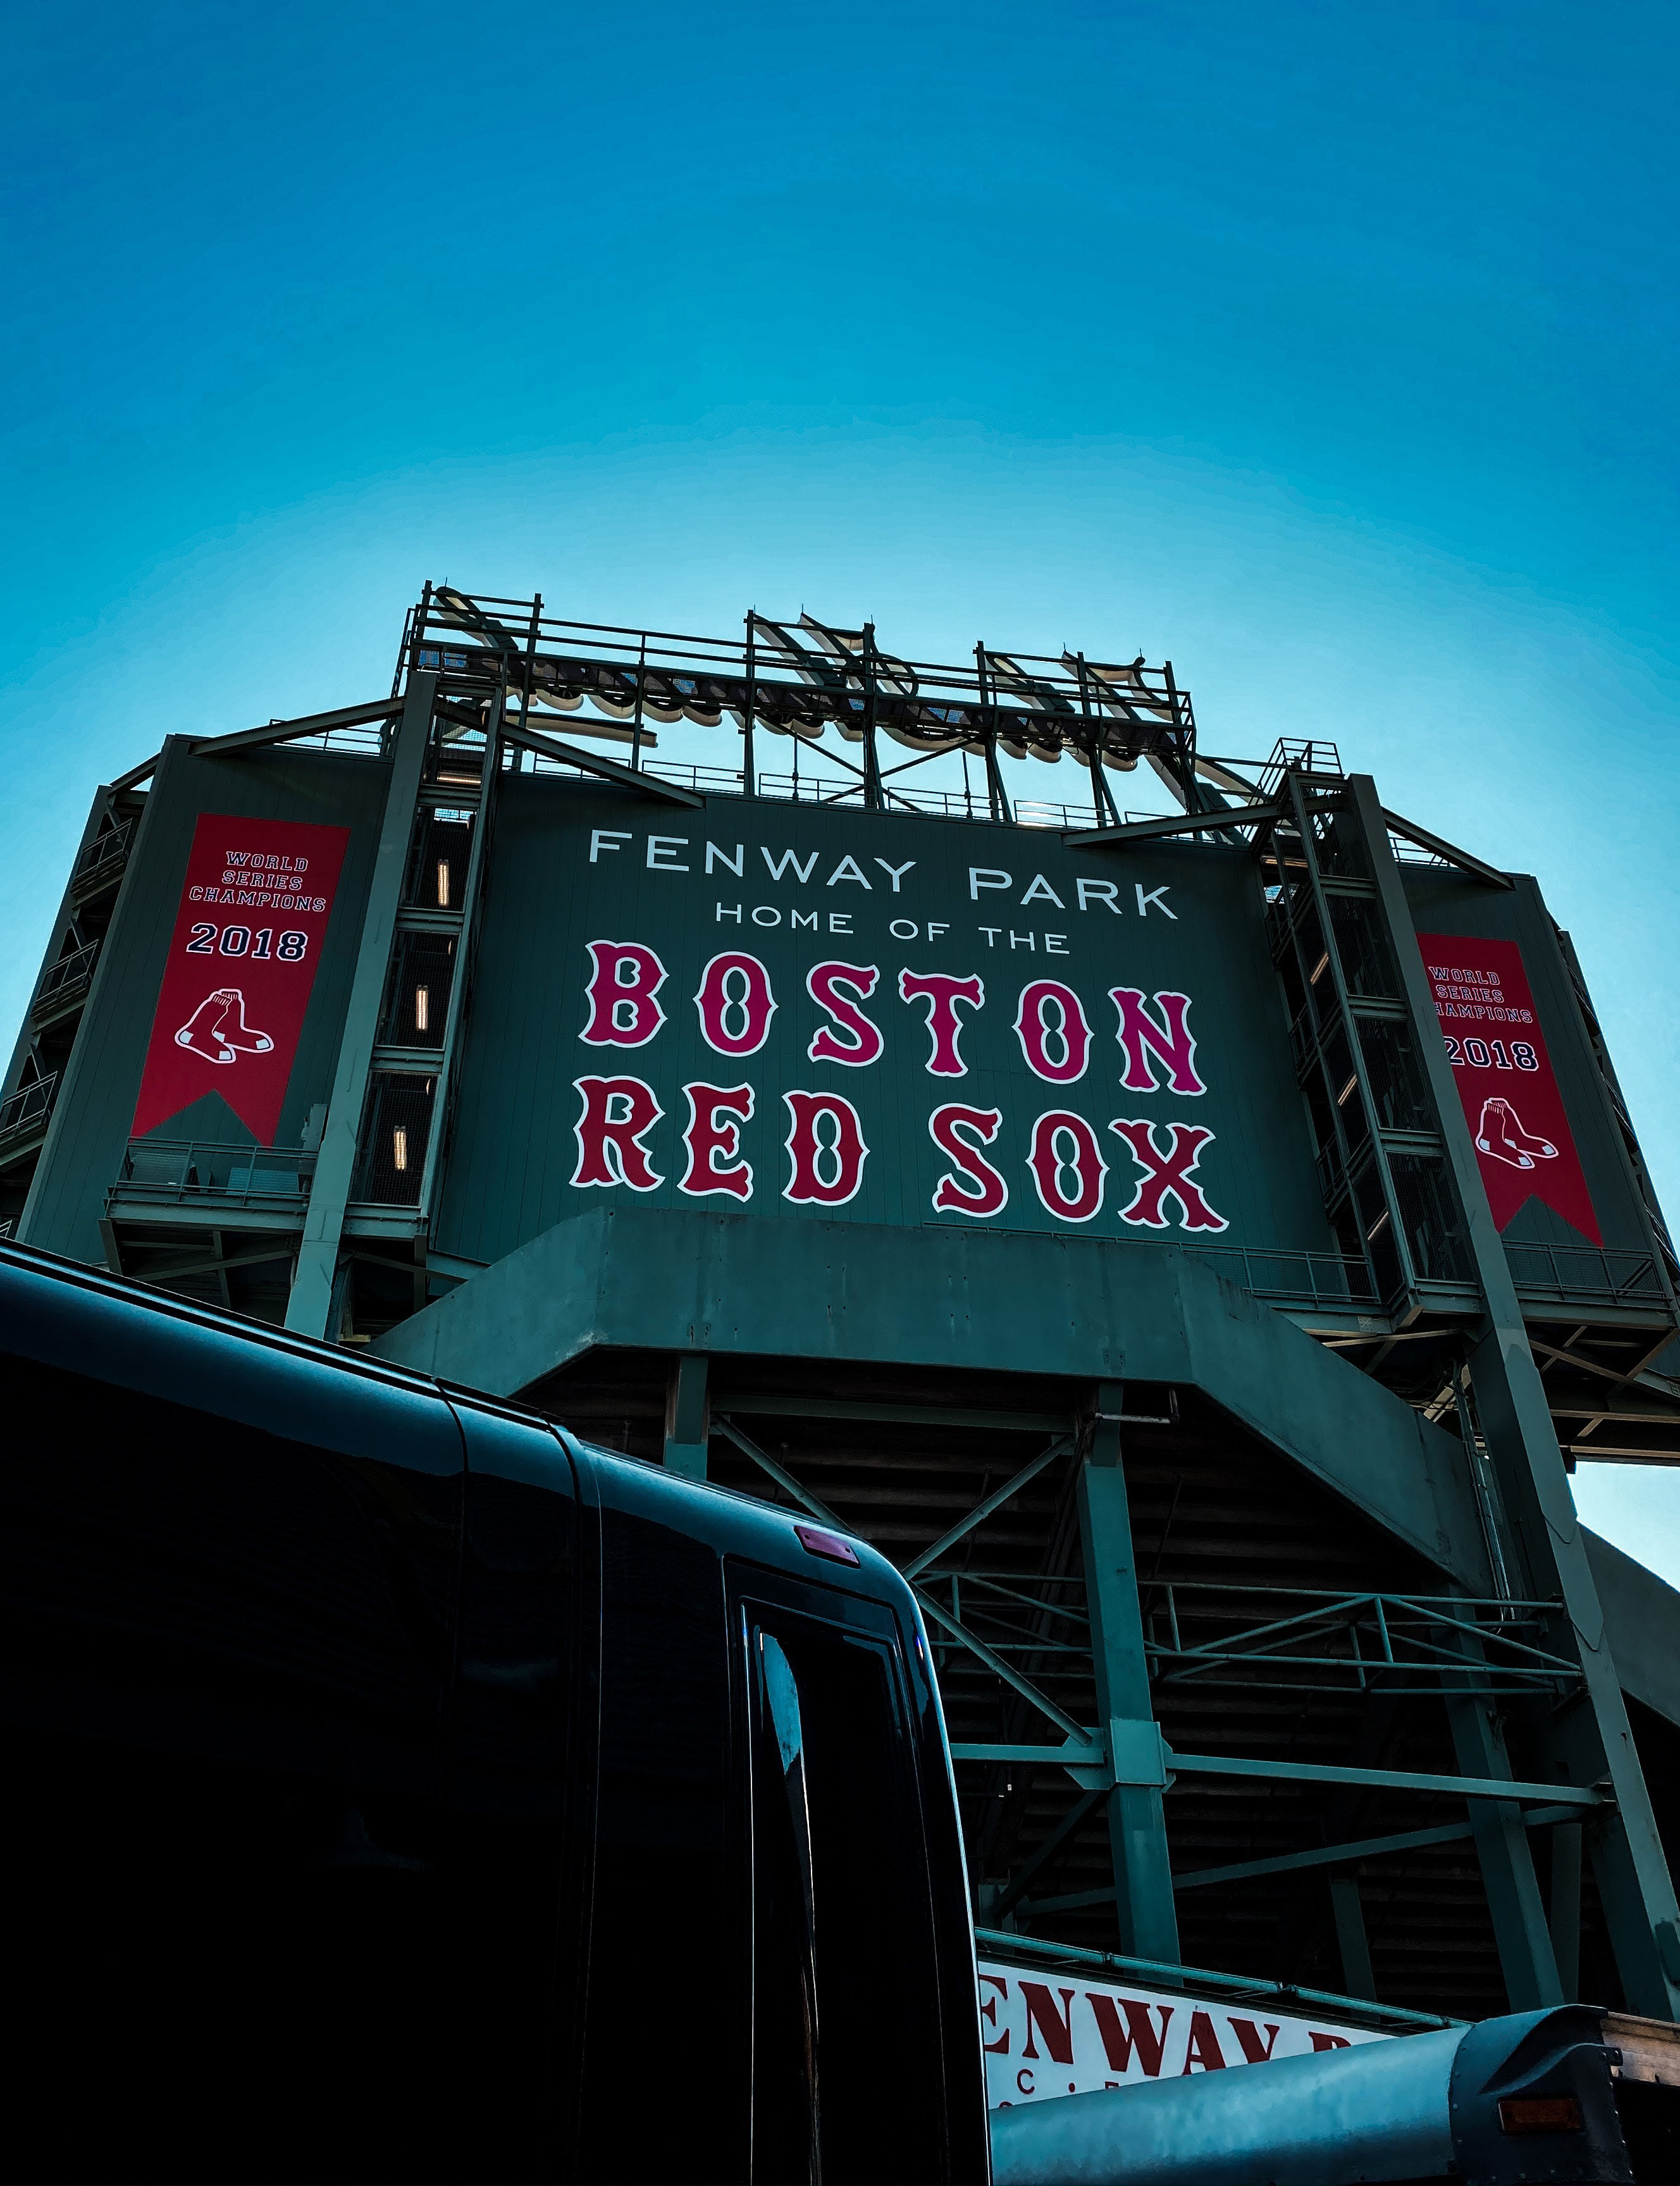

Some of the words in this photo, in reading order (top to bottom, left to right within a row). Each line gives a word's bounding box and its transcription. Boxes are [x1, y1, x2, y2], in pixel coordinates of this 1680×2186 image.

[226, 851, 309, 872] WORLD
[589, 829, 918, 892] FENWAY
[968, 867, 1178, 920] PARK
[222, 870, 302, 891] SERIES
[189, 886, 326, 911] CHAMPIONS
[186, 922, 309, 962] 2018
[716, 902, 854, 934] HOME
[889, 919, 950, 942] OF
[978, 927, 1070, 954] THE
[1428, 966, 1500, 985] WORLD
[1436, 984, 1504, 1003] SERIES
[578, 939, 1208, 1097] BOSTON
[1433, 1002, 1533, 1023] HAMPIONS
[1443, 1035, 1539, 1071] 2018
[568, 1075, 871, 1206] RED
[928, 1102, 1230, 1233] SOX
